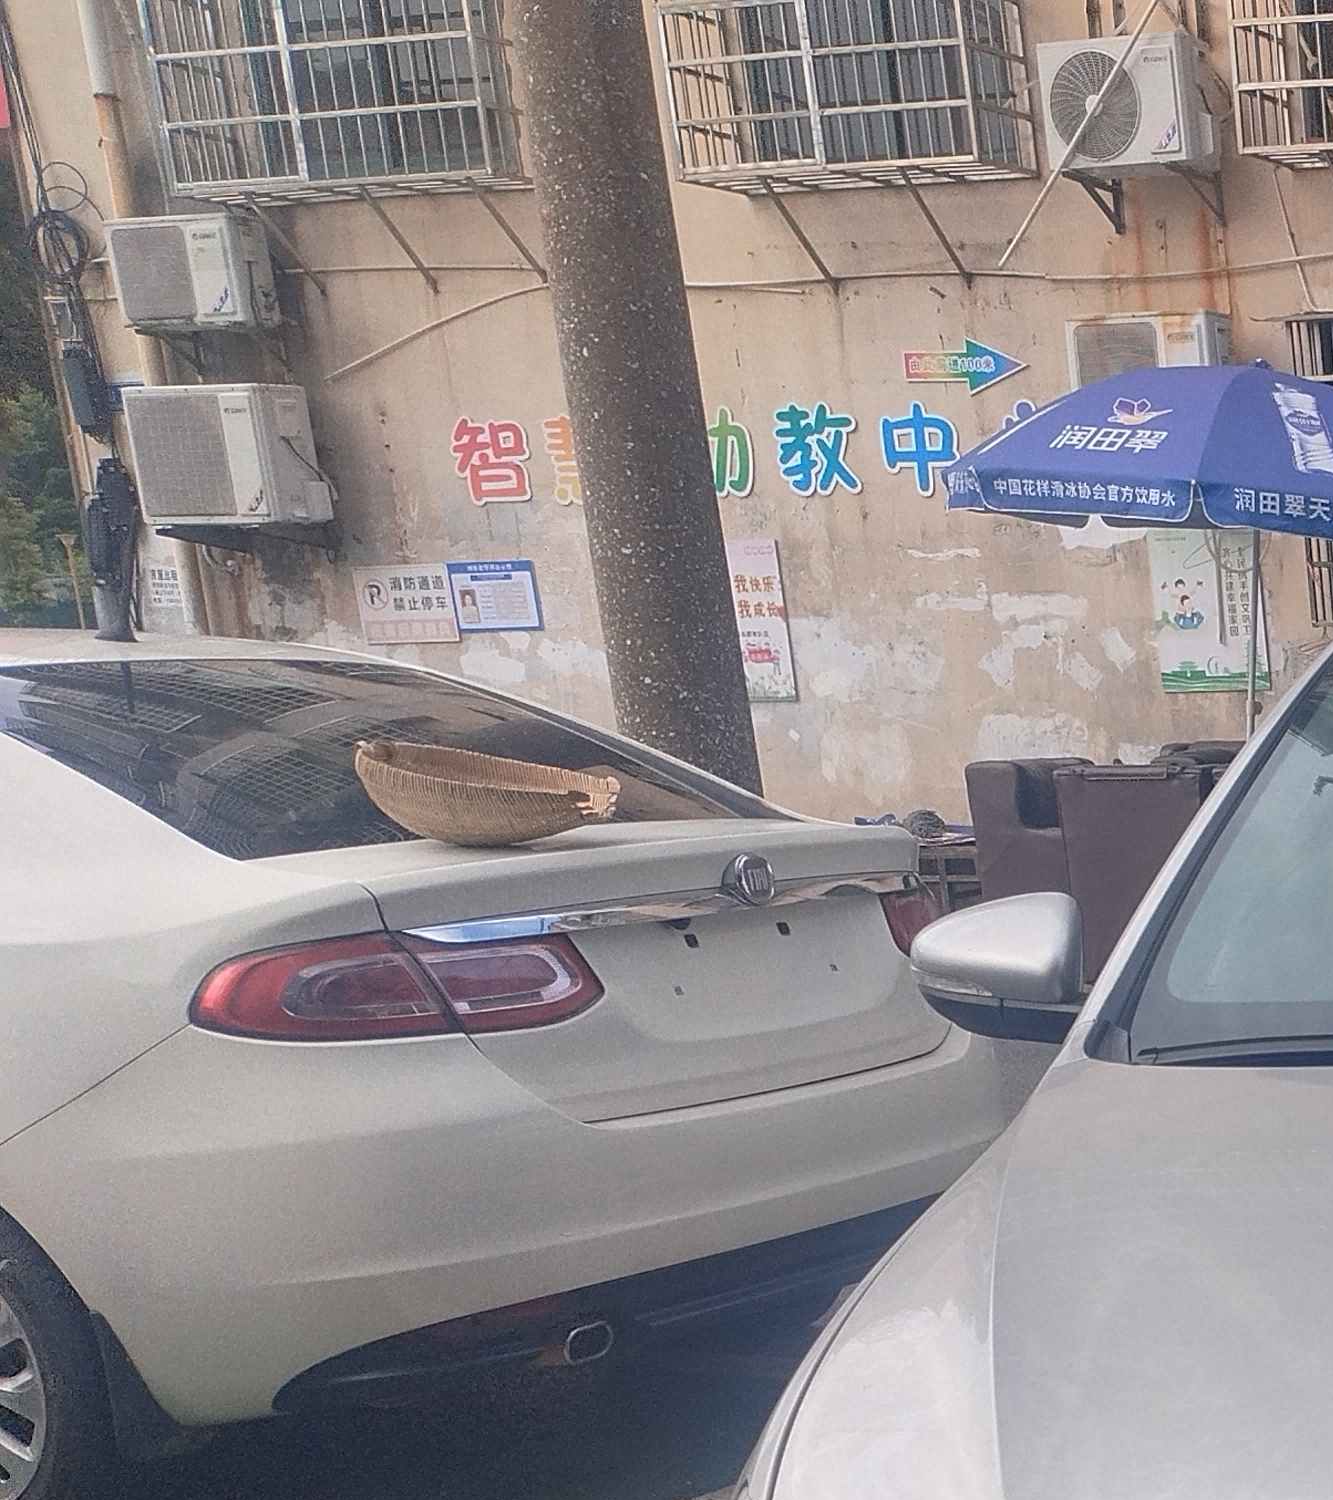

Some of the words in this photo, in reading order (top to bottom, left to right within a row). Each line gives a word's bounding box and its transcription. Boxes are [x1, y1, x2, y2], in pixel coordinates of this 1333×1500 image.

[1049, 425, 1168, 453] 润田翠
[993, 478, 1176, 508] 中国花样滑冰协会官方饮用水
[389, 575, 446, 592] 消防通道
[733, 574, 777, 593] 我快乐
[393, 596, 449, 612] 禁止停车
[737, 600, 779, 619] 我成长
